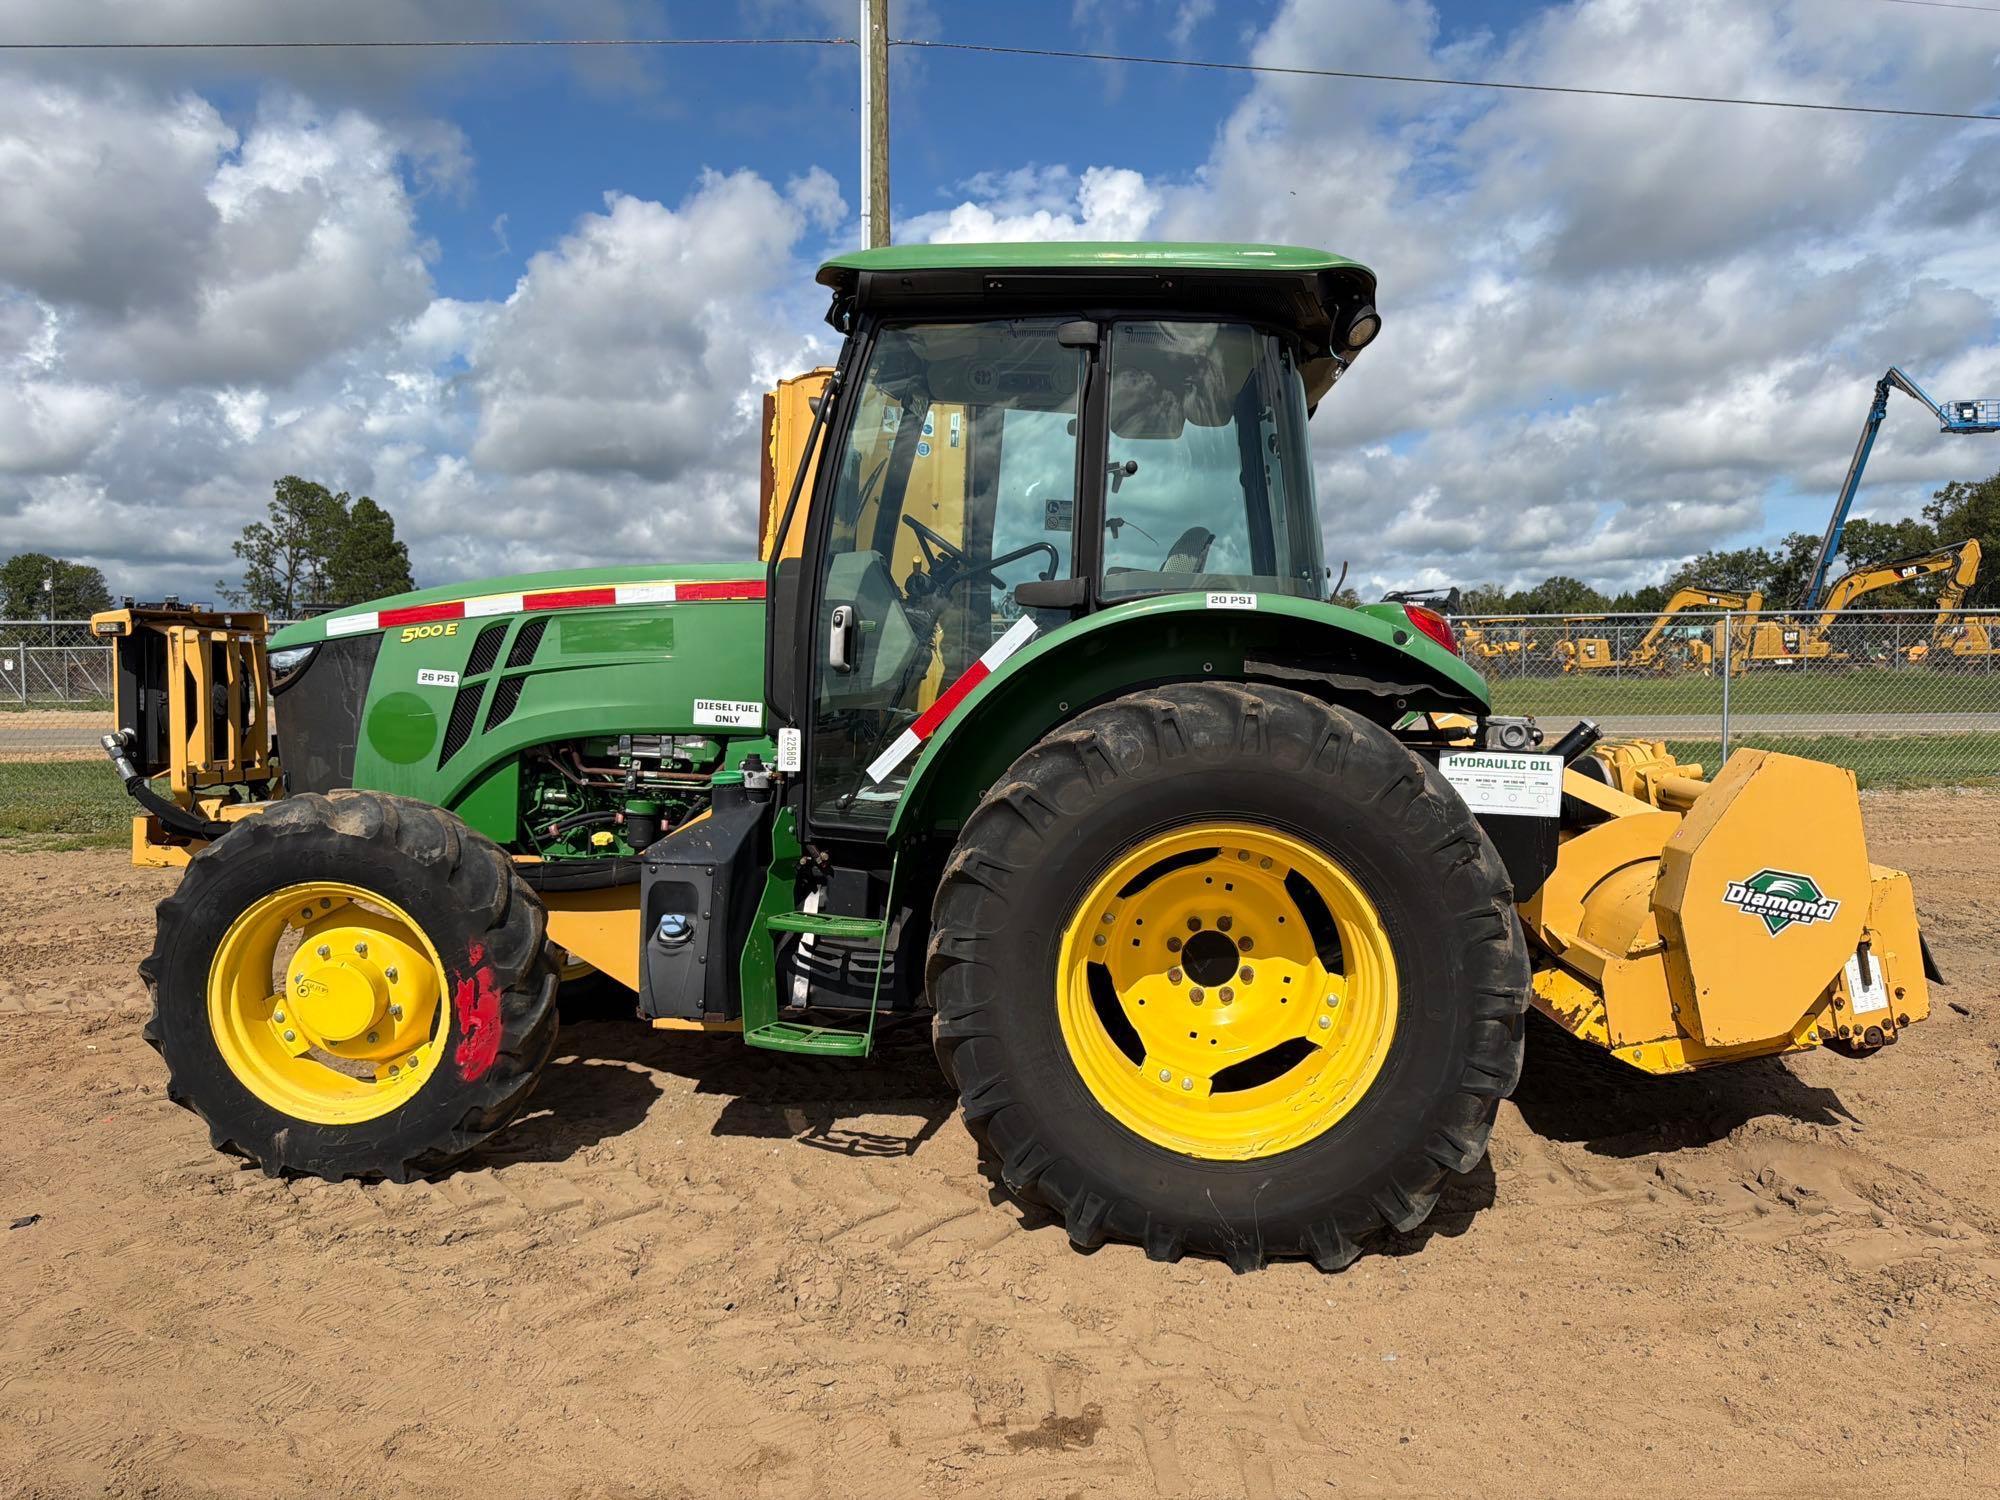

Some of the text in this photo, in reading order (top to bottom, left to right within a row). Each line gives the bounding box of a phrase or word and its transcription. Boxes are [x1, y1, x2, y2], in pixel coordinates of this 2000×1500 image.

[1901, 565, 1917, 578] CAT
[1211, 595, 1253, 605] 20 PSI
[400, 624, 444, 643] 5100
[1784, 632, 1799, 642] CAT
[421, 672, 456, 683] 26 PSI
[697, 701, 760, 713] DIESEL FUEL
[715, 714, 740, 724] ONLY
[786, 736, 797, 767] 225805
[1449, 756, 1553, 772] HYDRAULIC OIL
[1725, 885, 1837, 919] Diamond
[1744, 905, 1812, 922] MOWERS
